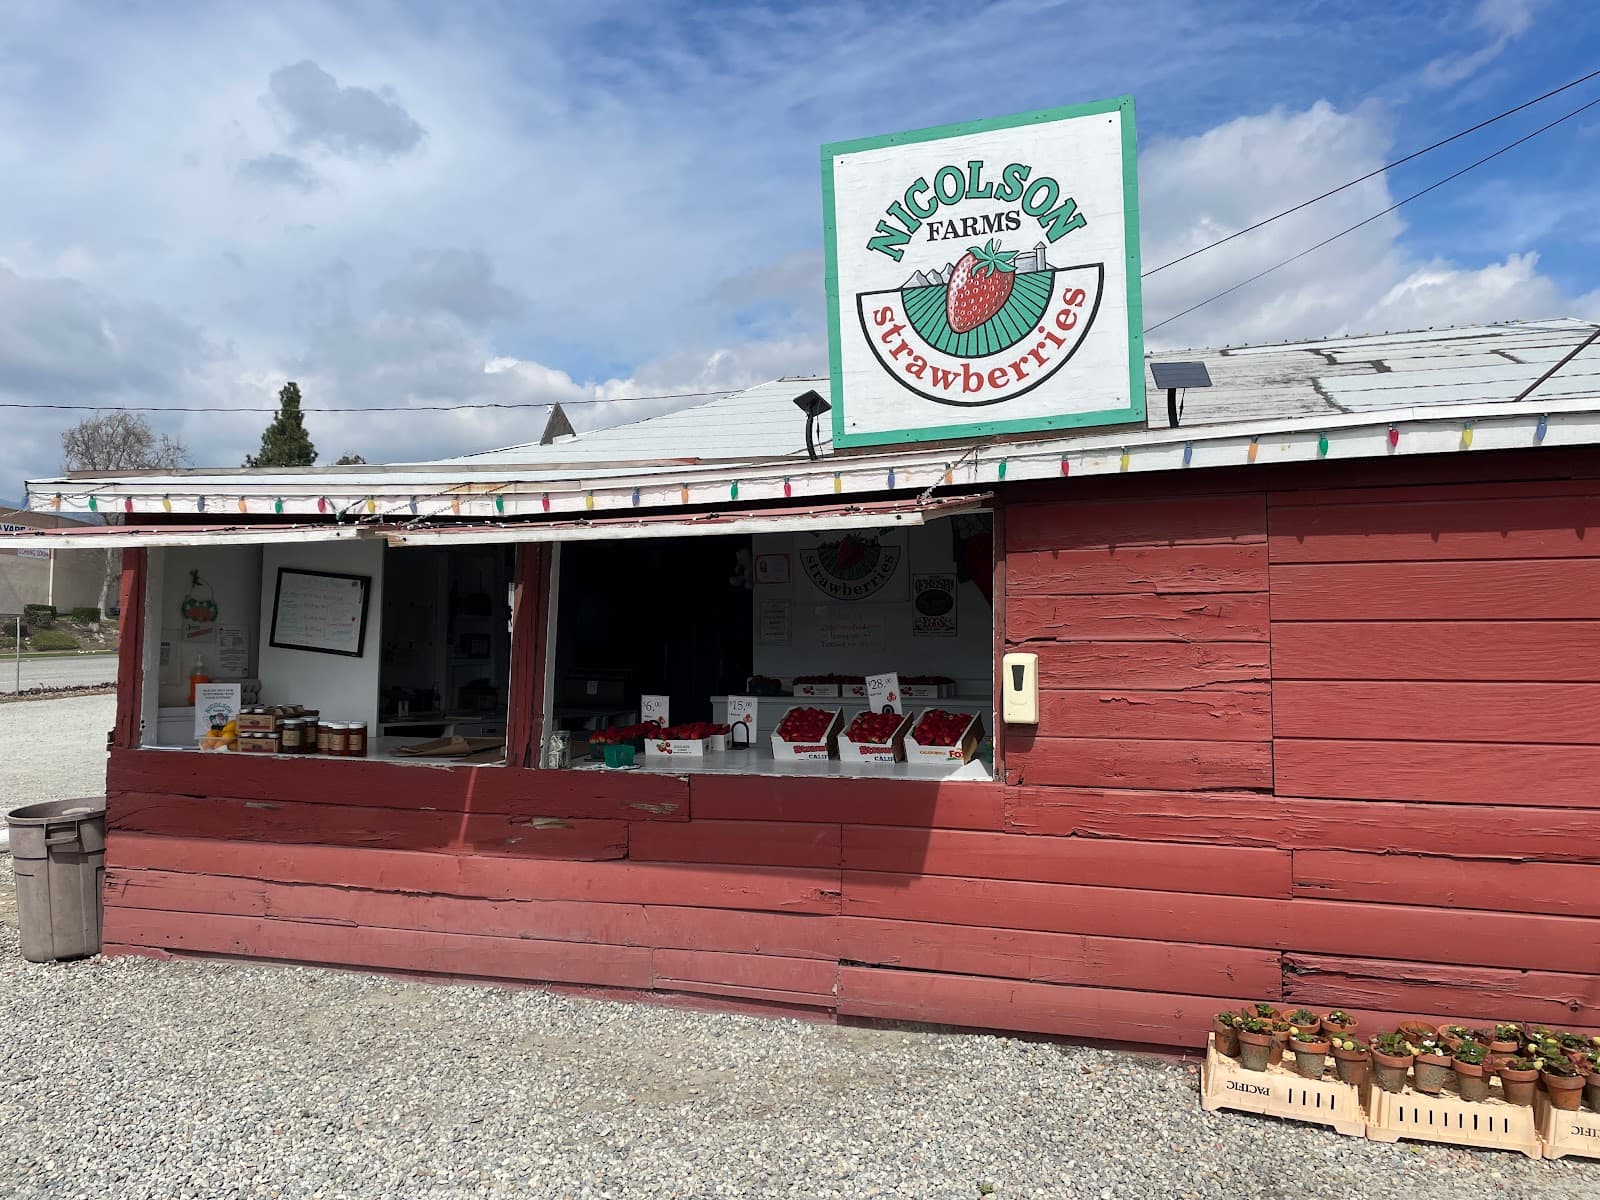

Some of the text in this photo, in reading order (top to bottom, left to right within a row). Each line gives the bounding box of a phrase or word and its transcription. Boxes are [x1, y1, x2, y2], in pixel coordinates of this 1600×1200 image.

[866, 160, 1087, 262] NICOLSON
[927, 210, 1021, 242] FARMS
[873, 287, 1086, 393] strawberries
[806, 554, 895, 597] strawberries
[1226, 1080, 1271, 1097] PACIFIC
